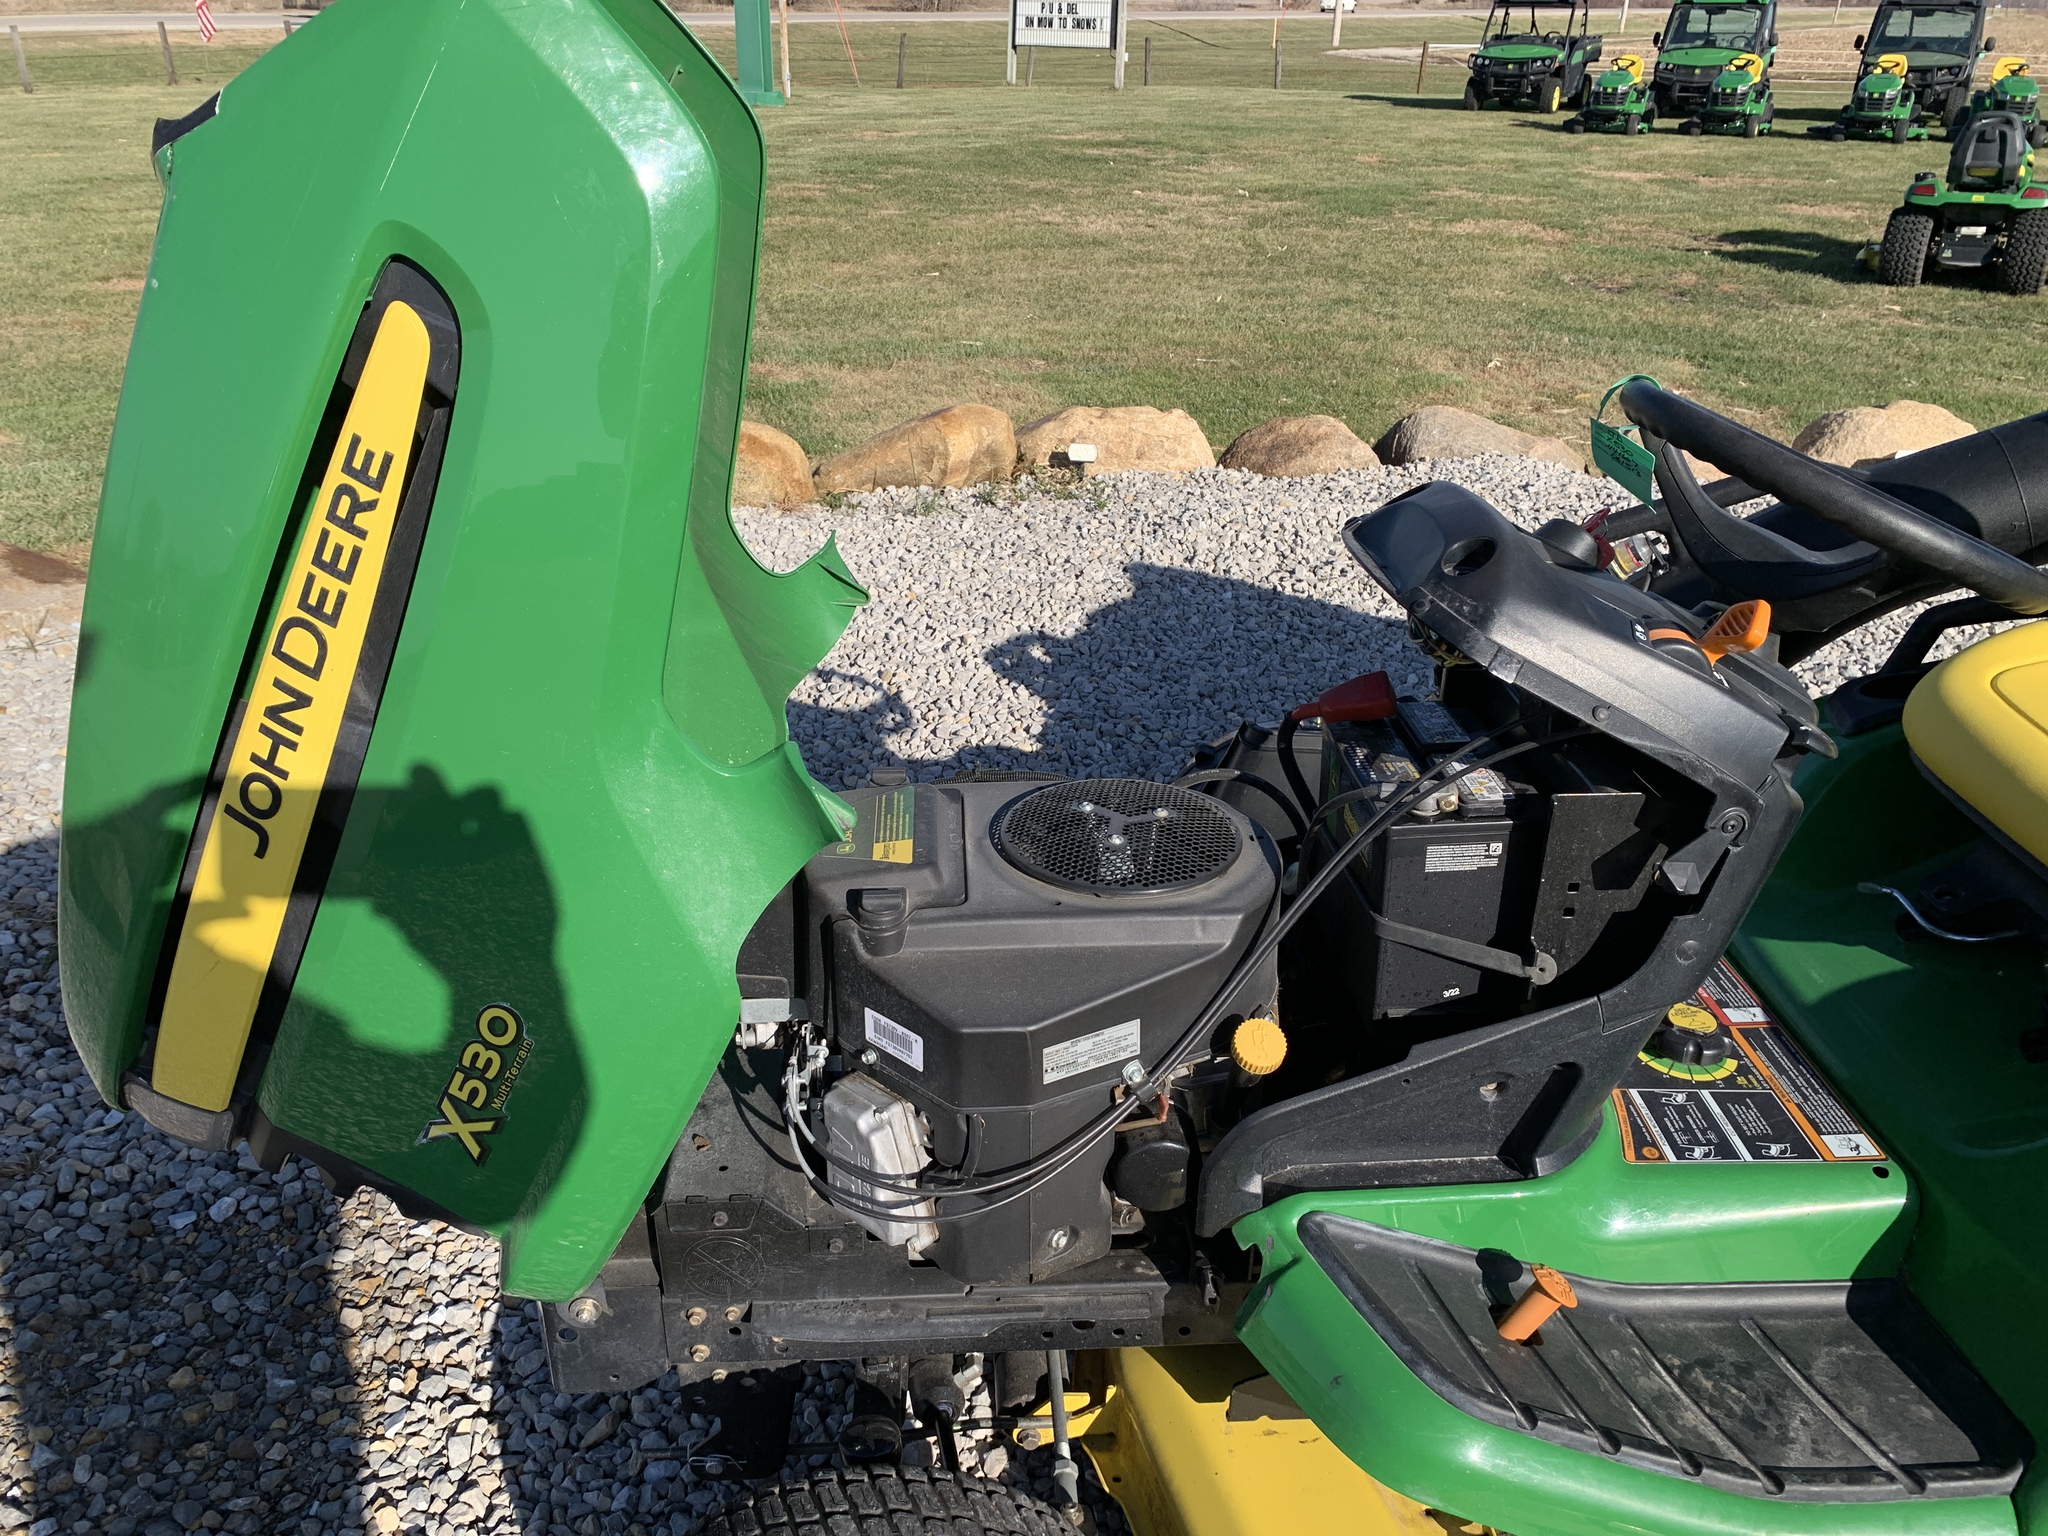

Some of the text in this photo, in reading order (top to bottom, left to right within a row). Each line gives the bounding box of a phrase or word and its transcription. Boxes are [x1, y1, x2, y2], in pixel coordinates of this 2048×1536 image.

[1057, 2, 1063, 14] &
[1066, 3, 1079, 15] DEL
[1025, 16, 1034, 28] ON
[1037, 16, 1054, 29] MOW
[1058, 17, 1067, 29] TO
[1071, 18, 1097, 30] SNOWS
[223, 432, 395, 859] JOHN DEERE
[1442, 987, 1460, 998] 3/22
[425, 1006, 518, 1162] X530
[490, 1039, 532, 1111] Multi-Terrain
[1763, 1074, 1789, 1099] WARNING
